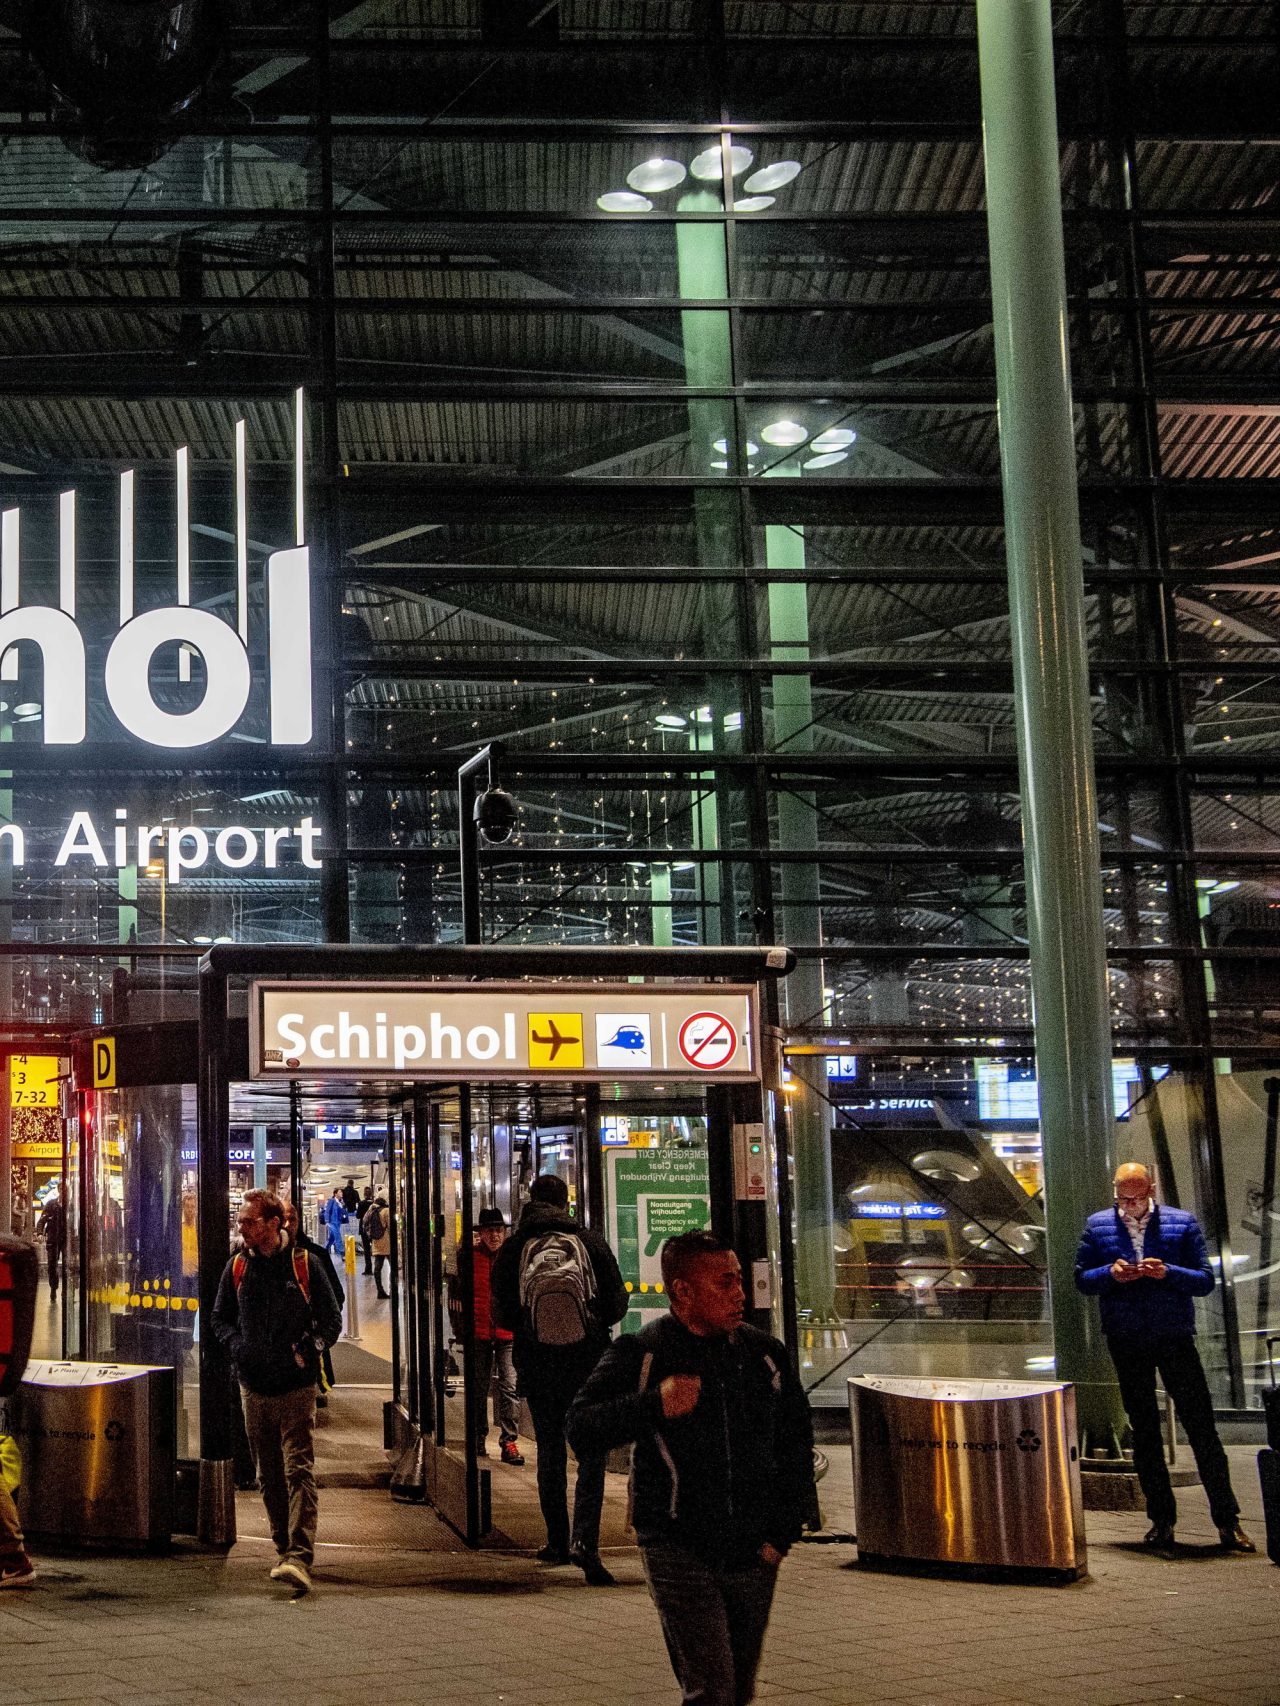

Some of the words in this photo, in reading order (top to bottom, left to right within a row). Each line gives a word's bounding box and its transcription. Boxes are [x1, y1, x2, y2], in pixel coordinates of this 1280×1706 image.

[54, 807, 322, 884] Airport
[277, 1011, 516, 1069] Schiphol
[97, 1043, 111, 1081] D
[828, 1066, 835, 1075] 2
[18, 1072, 26, 1085] 3
[13, 1091, 47, 1103] 7-32
[29, 1145, 61, 1155] Airport
[650, 1201, 692, 1209] Nooduitgang
[946, 1439, 959, 1449] to
